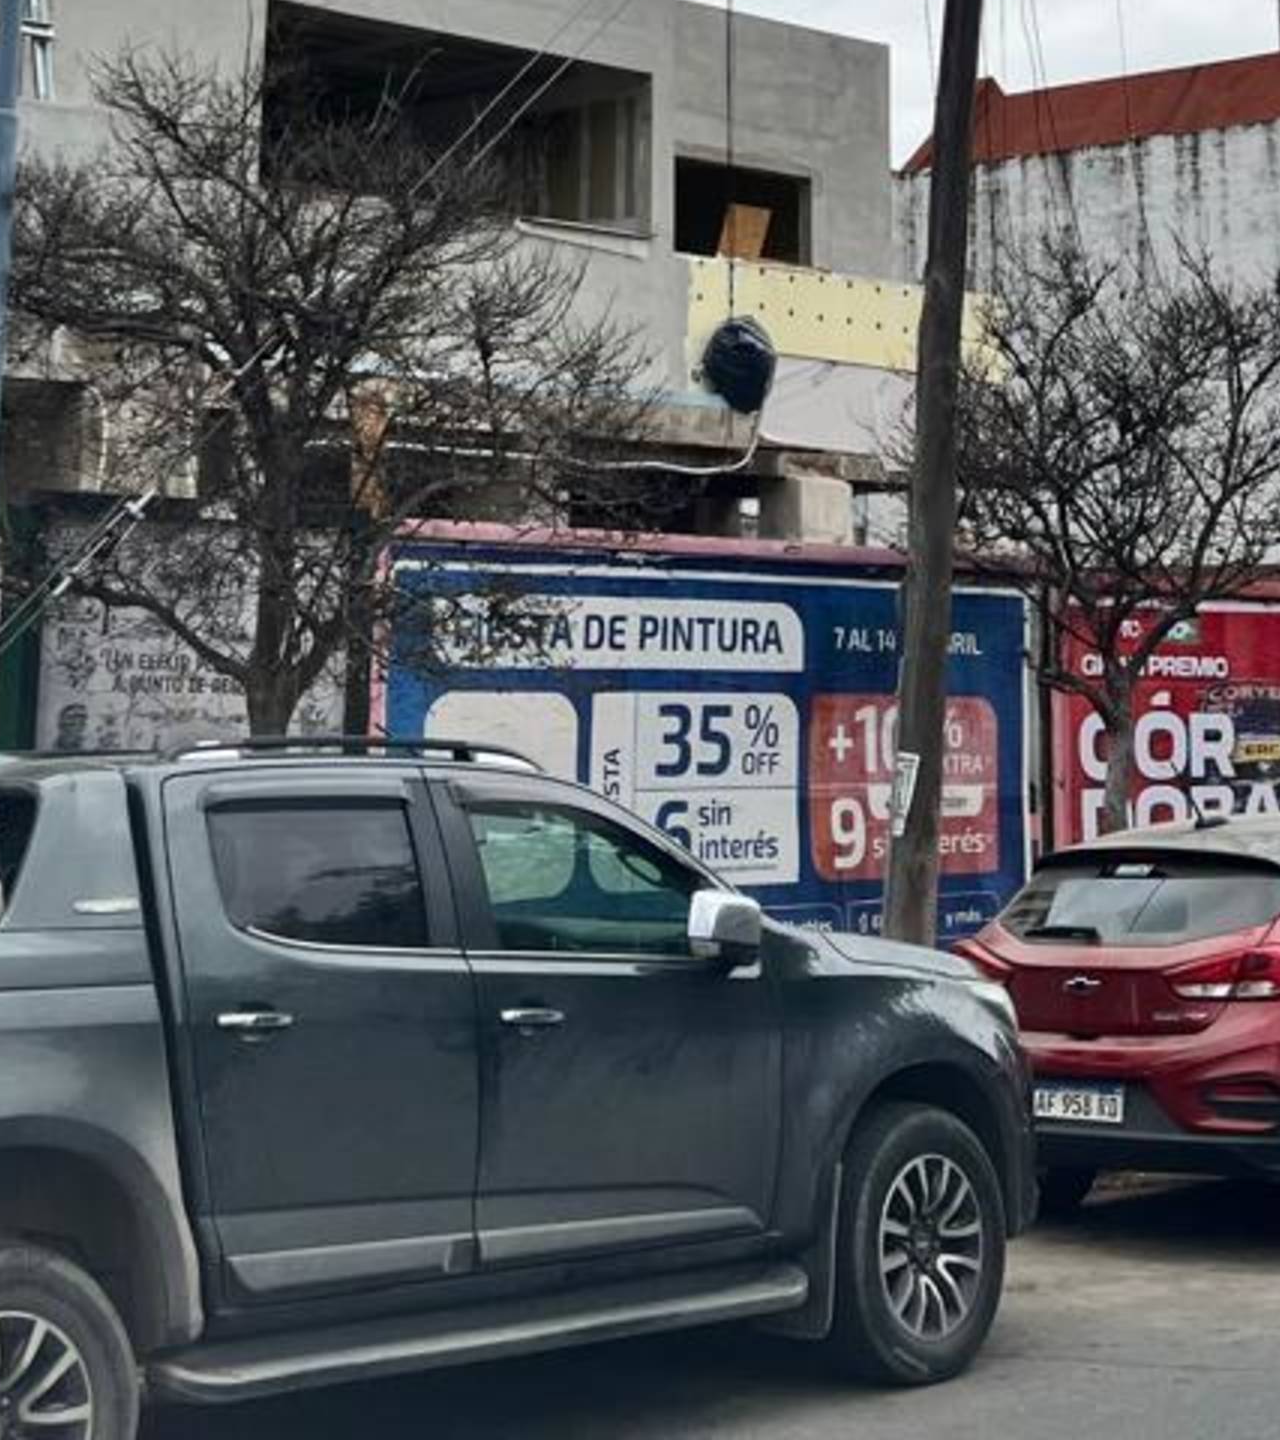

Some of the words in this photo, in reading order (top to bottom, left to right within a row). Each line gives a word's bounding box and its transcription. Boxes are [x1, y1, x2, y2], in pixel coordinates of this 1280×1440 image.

[583, 614, 627, 650] DE
[639, 616, 784, 653] PINTURA
[833, 626, 844, 649] 7
[848, 629, 872, 652] AL
[878, 629, 896, 652] 14
[946, 632, 984, 655] RIL
[1148, 655, 1229, 678] PREMIO
[603, 749, 620, 796] STA
[742, 752, 780, 776] OFF
[698, 799, 731, 825] sin
[831, 797, 866, 870] 9
[939, 828, 985, 854] erés
[698, 835, 779, 860] interés
